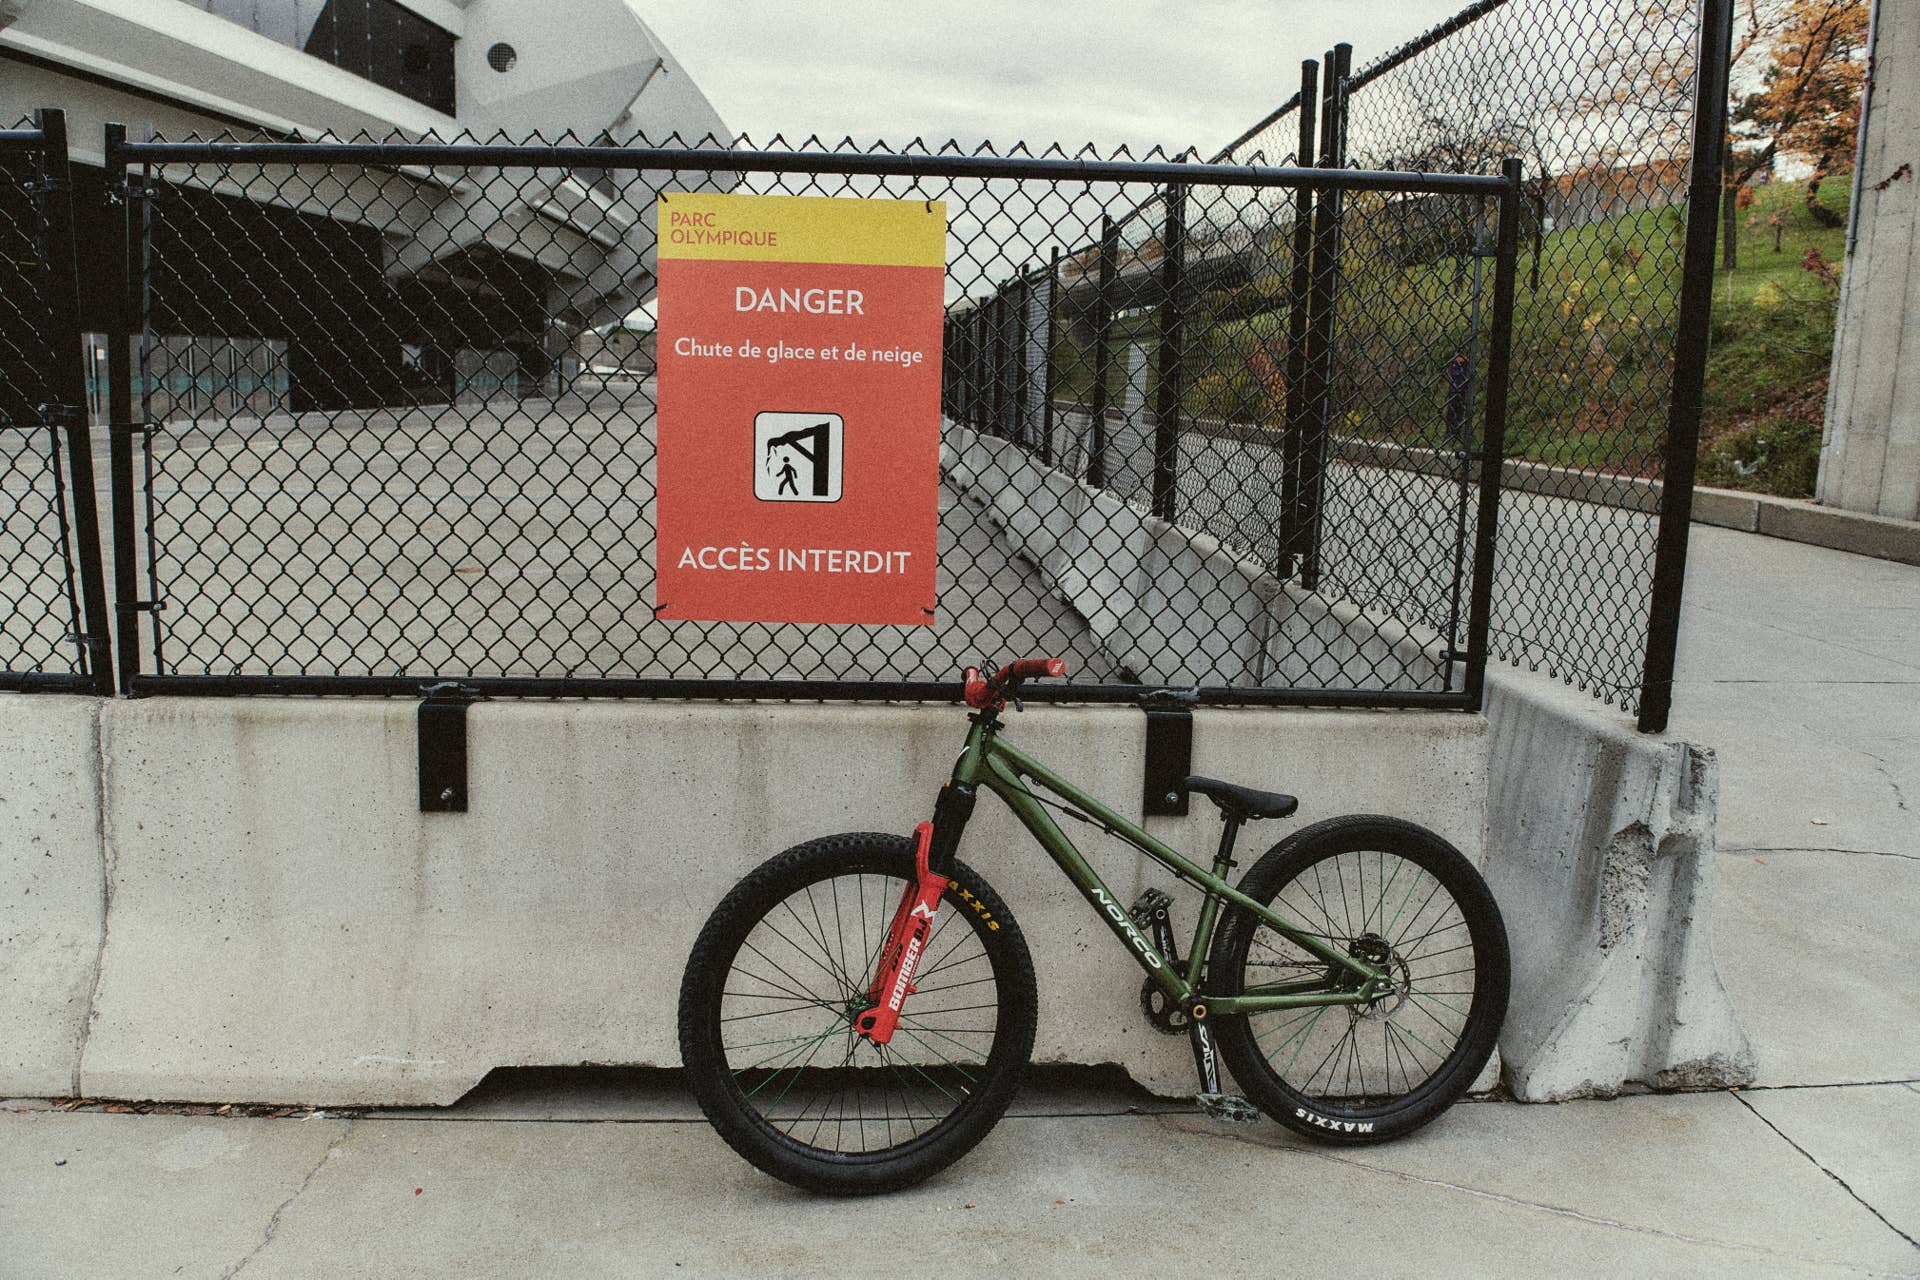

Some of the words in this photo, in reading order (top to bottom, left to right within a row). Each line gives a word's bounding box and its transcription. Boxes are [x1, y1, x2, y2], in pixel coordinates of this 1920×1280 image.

[670, 211, 716, 228] PARC
[670, 229, 777, 247] OLYMPIQUE
[735, 286, 864, 315] DANGER
[674, 337, 733, 359] Chute
[738, 339, 762, 360] de
[766, 340, 815, 364] glace
[820, 345, 839, 362] et
[844, 342, 867, 362] de
[872, 346, 923, 368] neige
[677, 541, 771, 571] ACCÈS
[778, 548, 912, 574] INTERDIT
[949, 881, 999, 930] AXXIS
[1091, 888, 1161, 968] NORCO
[888, 937, 922, 1011] BOMBER
[1296, 1108, 1374, 1133] MAXXIS
